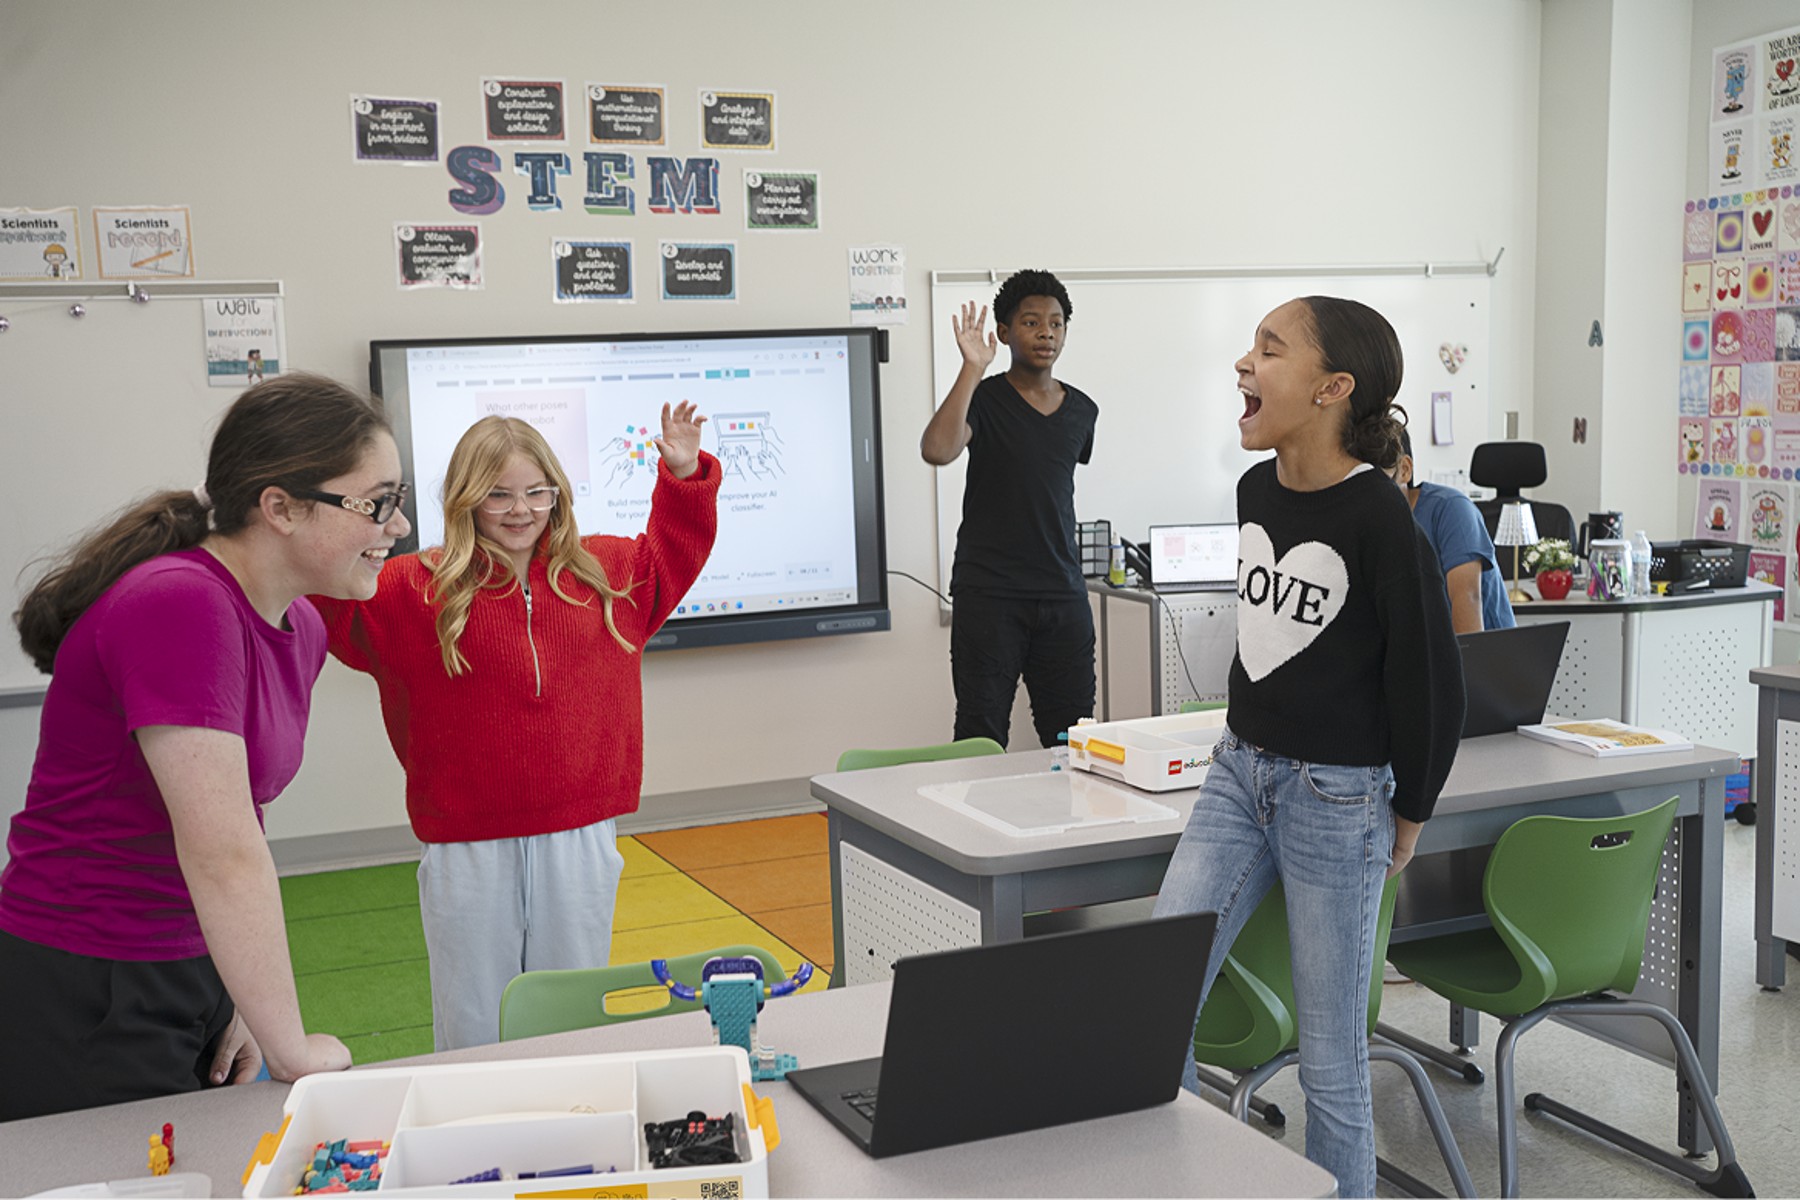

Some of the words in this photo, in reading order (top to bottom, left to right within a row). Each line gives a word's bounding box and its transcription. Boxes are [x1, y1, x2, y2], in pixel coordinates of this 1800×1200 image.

[1768, 38, 1784, 51] YOU
[489, 82, 497, 93] 6
[504, 87, 547, 98] Construct
[594, 87, 600, 98] 5
[706, 93, 712, 104] 4
[361, 101, 367, 112] 7
[497, 99, 555, 112] explanations
[596, 103, 642, 113] mathematics
[643, 105, 658, 113] and
[721, 103, 755, 117] Analyze
[381, 108, 414, 124] Engage
[503, 110, 521, 121] and
[522, 111, 551, 125] design
[711, 115, 728, 125] and
[729, 115, 765, 128] interpret
[369, 121, 380, 131] in
[380, 121, 426, 135] argument
[506, 121, 548, 133] solutions
[612, 122, 642, 136] thinking
[728, 125, 749, 136] data
[367, 131, 393, 147] from
[393, 133, 429, 145] evidence
[446, 145, 720, 216] STEM
[751, 175, 758, 185] 3
[763, 183, 784, 194] Plan
[784, 184, 801, 194] and
[1, 218, 59, 229] Scientists
[115, 218, 170, 229] Scientists
[107, 228, 182, 249] record
[449, 243, 467, 253] and
[667, 245, 673, 255] 2
[576, 259, 616, 272] questions
[674, 259, 706, 273] Develop
[707, 260, 724, 270] and
[573, 270, 591, 280] and
[677, 273, 691, 281] use
[691, 271, 722, 281] models
[573, 281, 616, 294] problems
[207, 328, 273, 338] INSTRUCTIONS
[1588, 320, 1603, 347] A
[485, 402, 512, 412] What
[513, 401, 538, 411] other
[540, 400, 568, 412] poses
[529, 415, 555, 425] robot
[1573, 417, 1587, 444] N
[751, 492, 767, 500] your
[768, 490, 778, 498] AI
[607, 499, 628, 508] Build
[629, 498, 650, 506] more
[731, 502, 767, 513] classifier.
[616, 510, 627, 519] for
[628, 510, 646, 520] your
[1238, 558, 1330, 626] LOVE
[1183, 756, 1214, 770] educat
